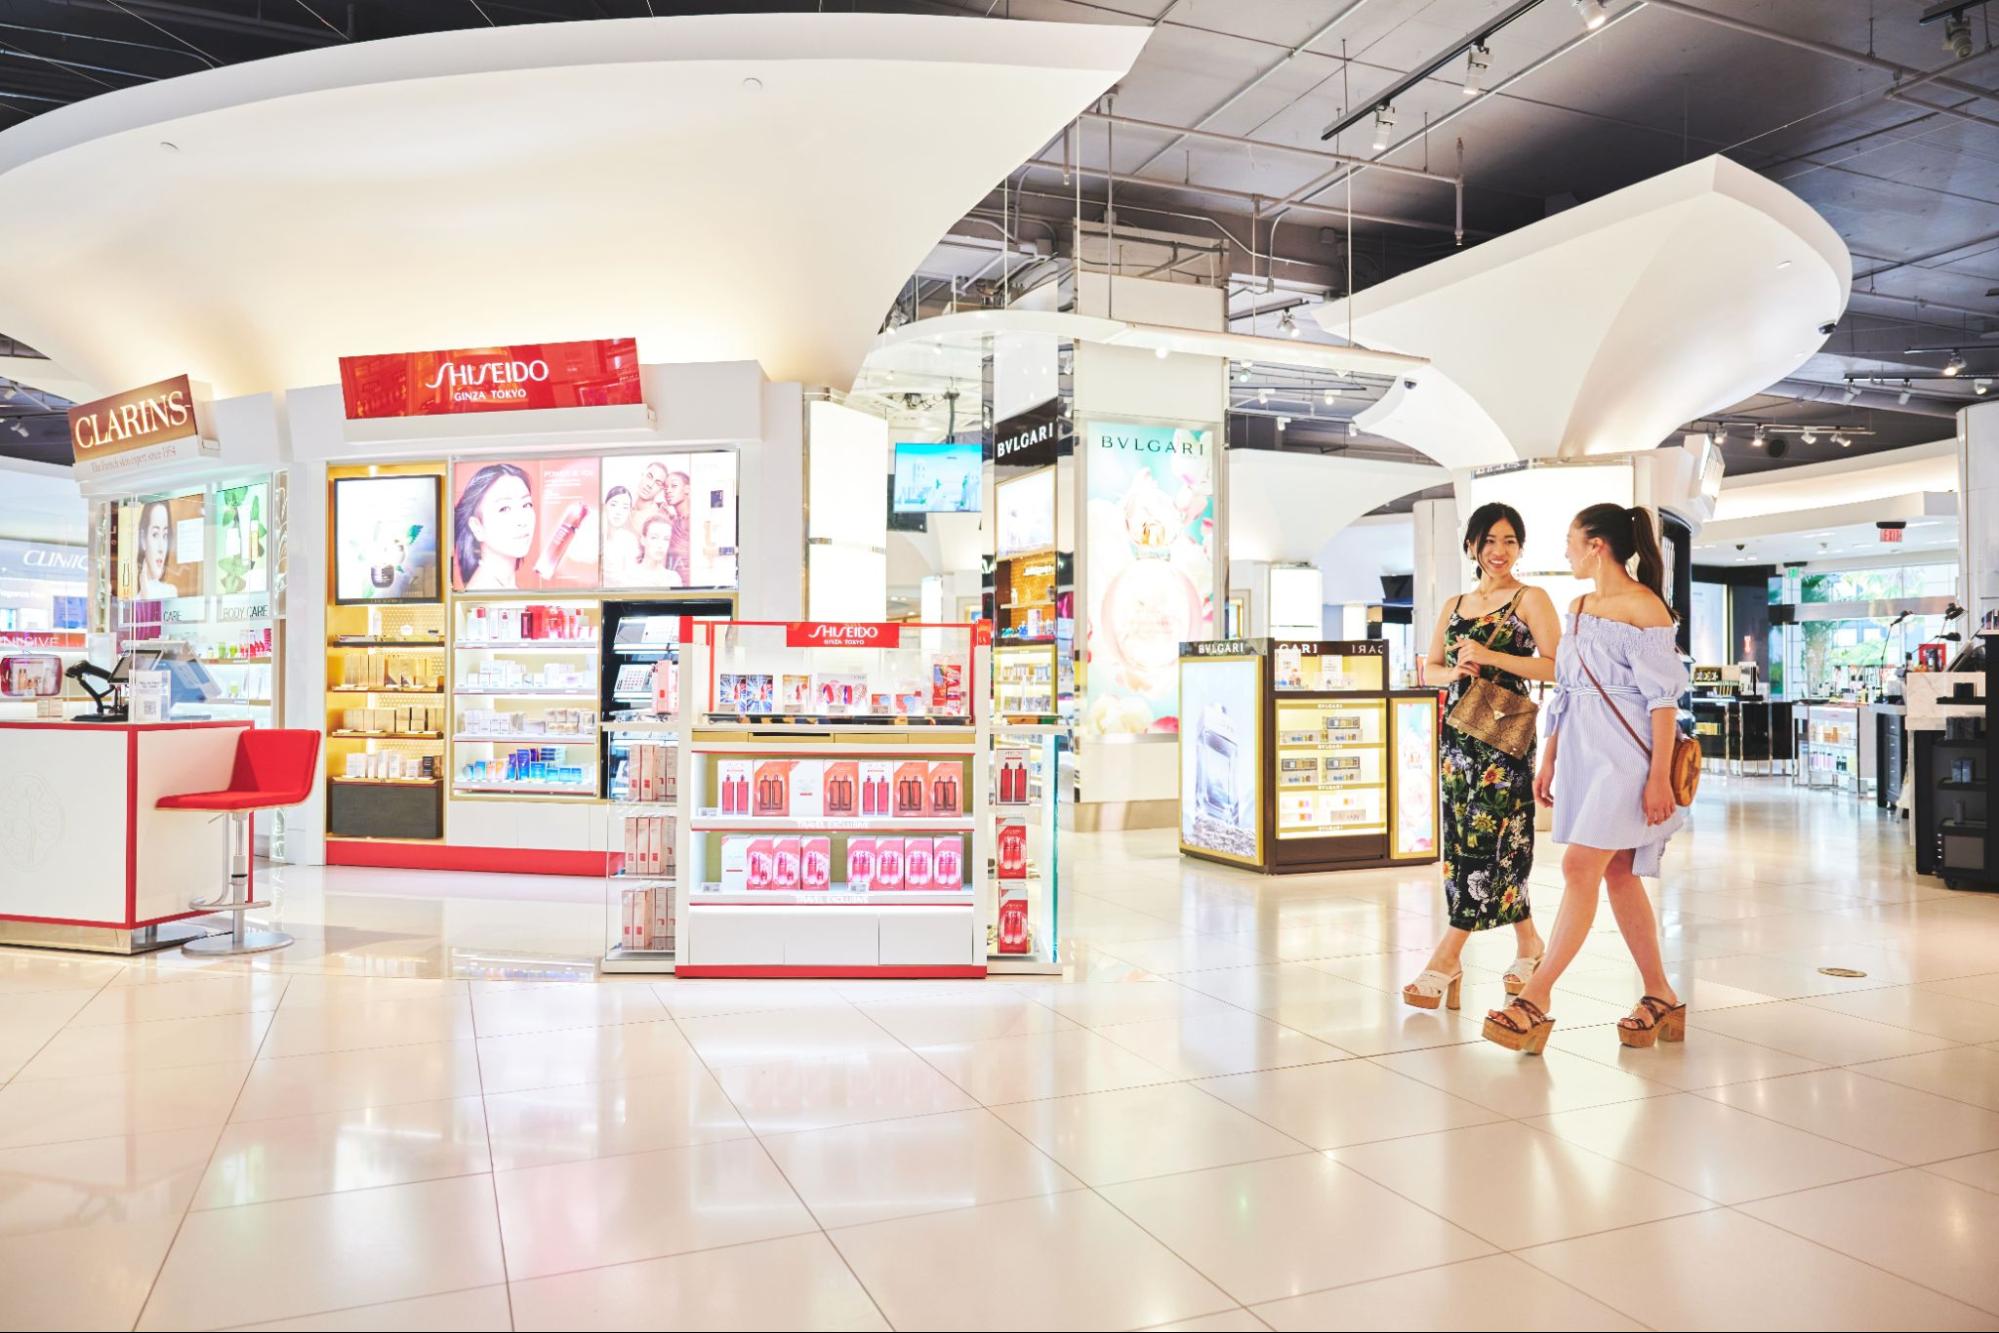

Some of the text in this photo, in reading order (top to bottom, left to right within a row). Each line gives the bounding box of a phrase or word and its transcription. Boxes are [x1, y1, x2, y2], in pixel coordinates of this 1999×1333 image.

[424, 360, 550, 389] SHISEIDO
[454, 388, 527, 402] GINZA TOKYO
[75, 390, 188, 449] CLARINS
[997, 422, 1054, 458] BVLGARI
[1101, 435, 1204, 457] BVLGARI
[163, 610, 182, 622] CARE
[247, 604, 269, 617] CARE
[808, 625, 879, 639] SHISEIDO
[1198, 642, 1245, 655] BVLGARI
